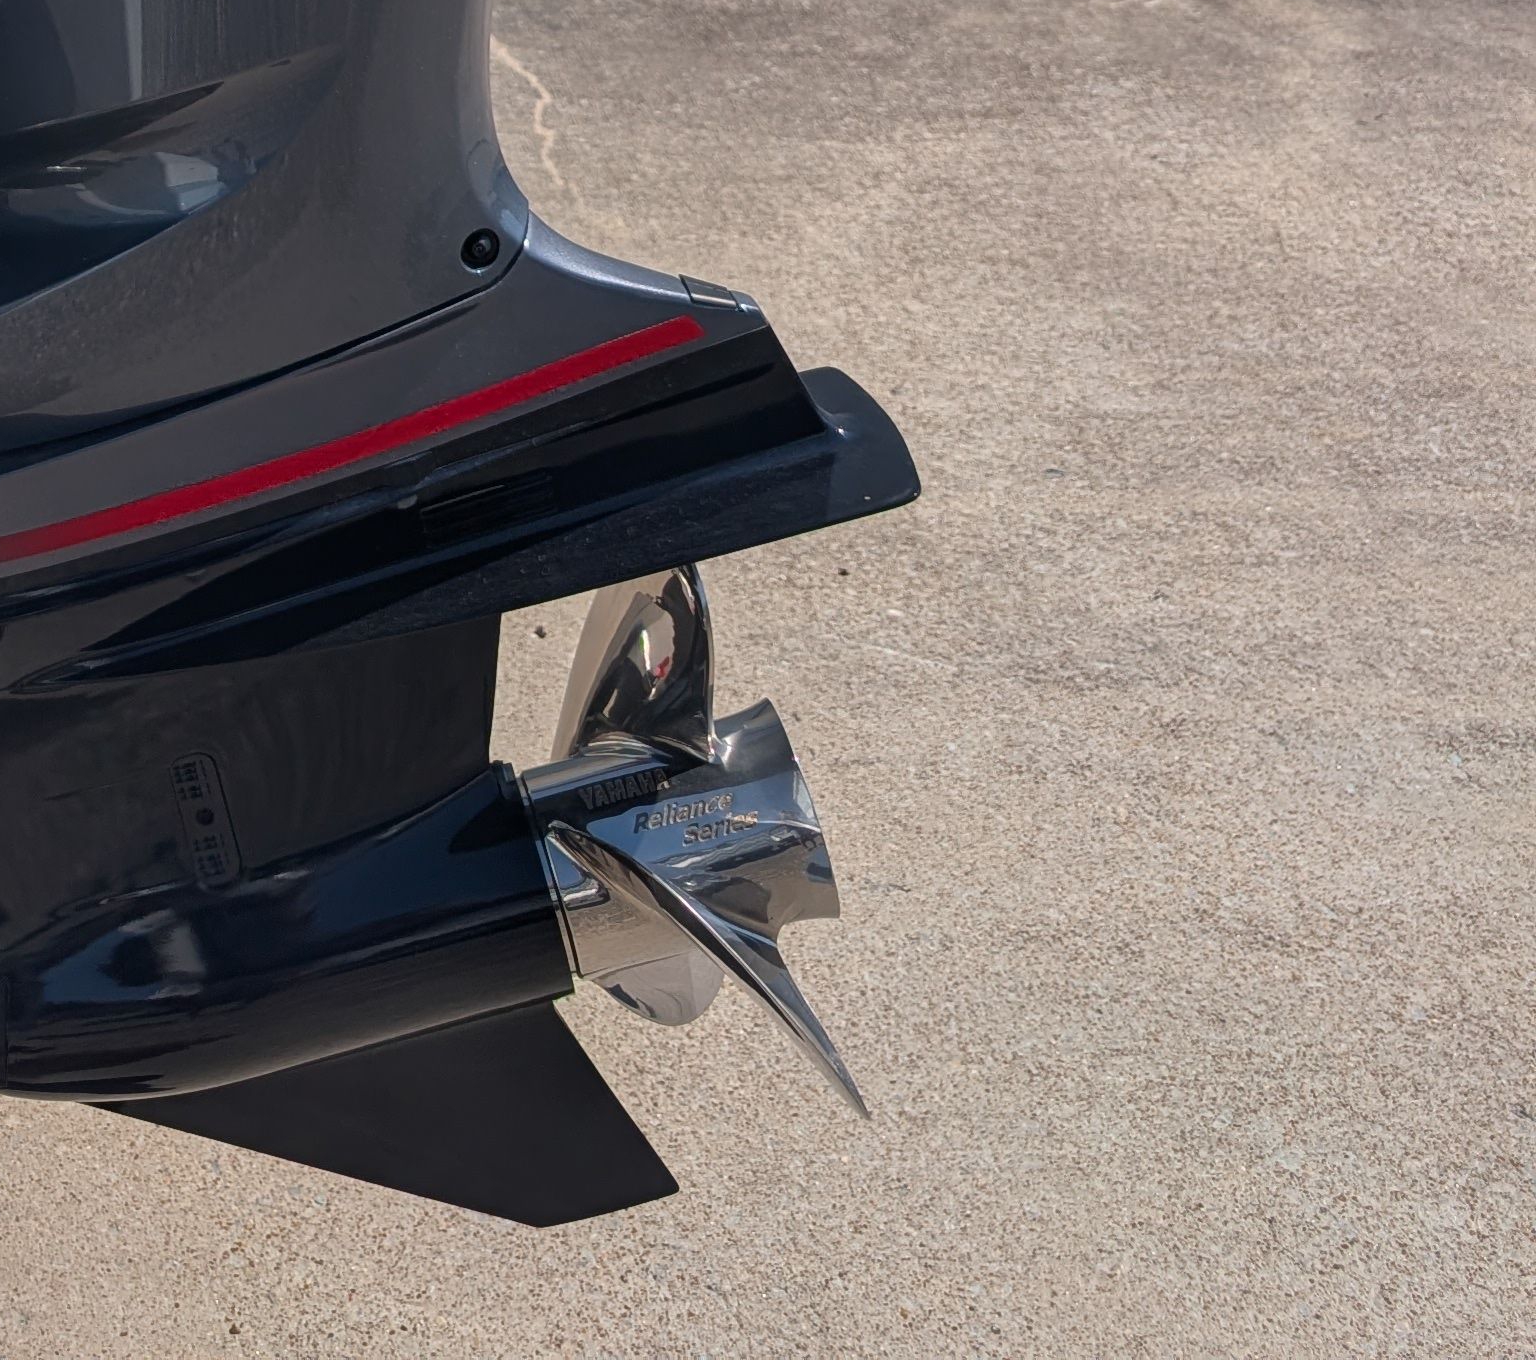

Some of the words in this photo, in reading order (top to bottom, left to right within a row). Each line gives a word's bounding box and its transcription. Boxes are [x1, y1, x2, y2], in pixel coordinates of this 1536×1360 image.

[578, 768, 671, 811] YAMAHA
[633, 792, 734, 834] Reliance
[682, 810, 760, 847] Series
